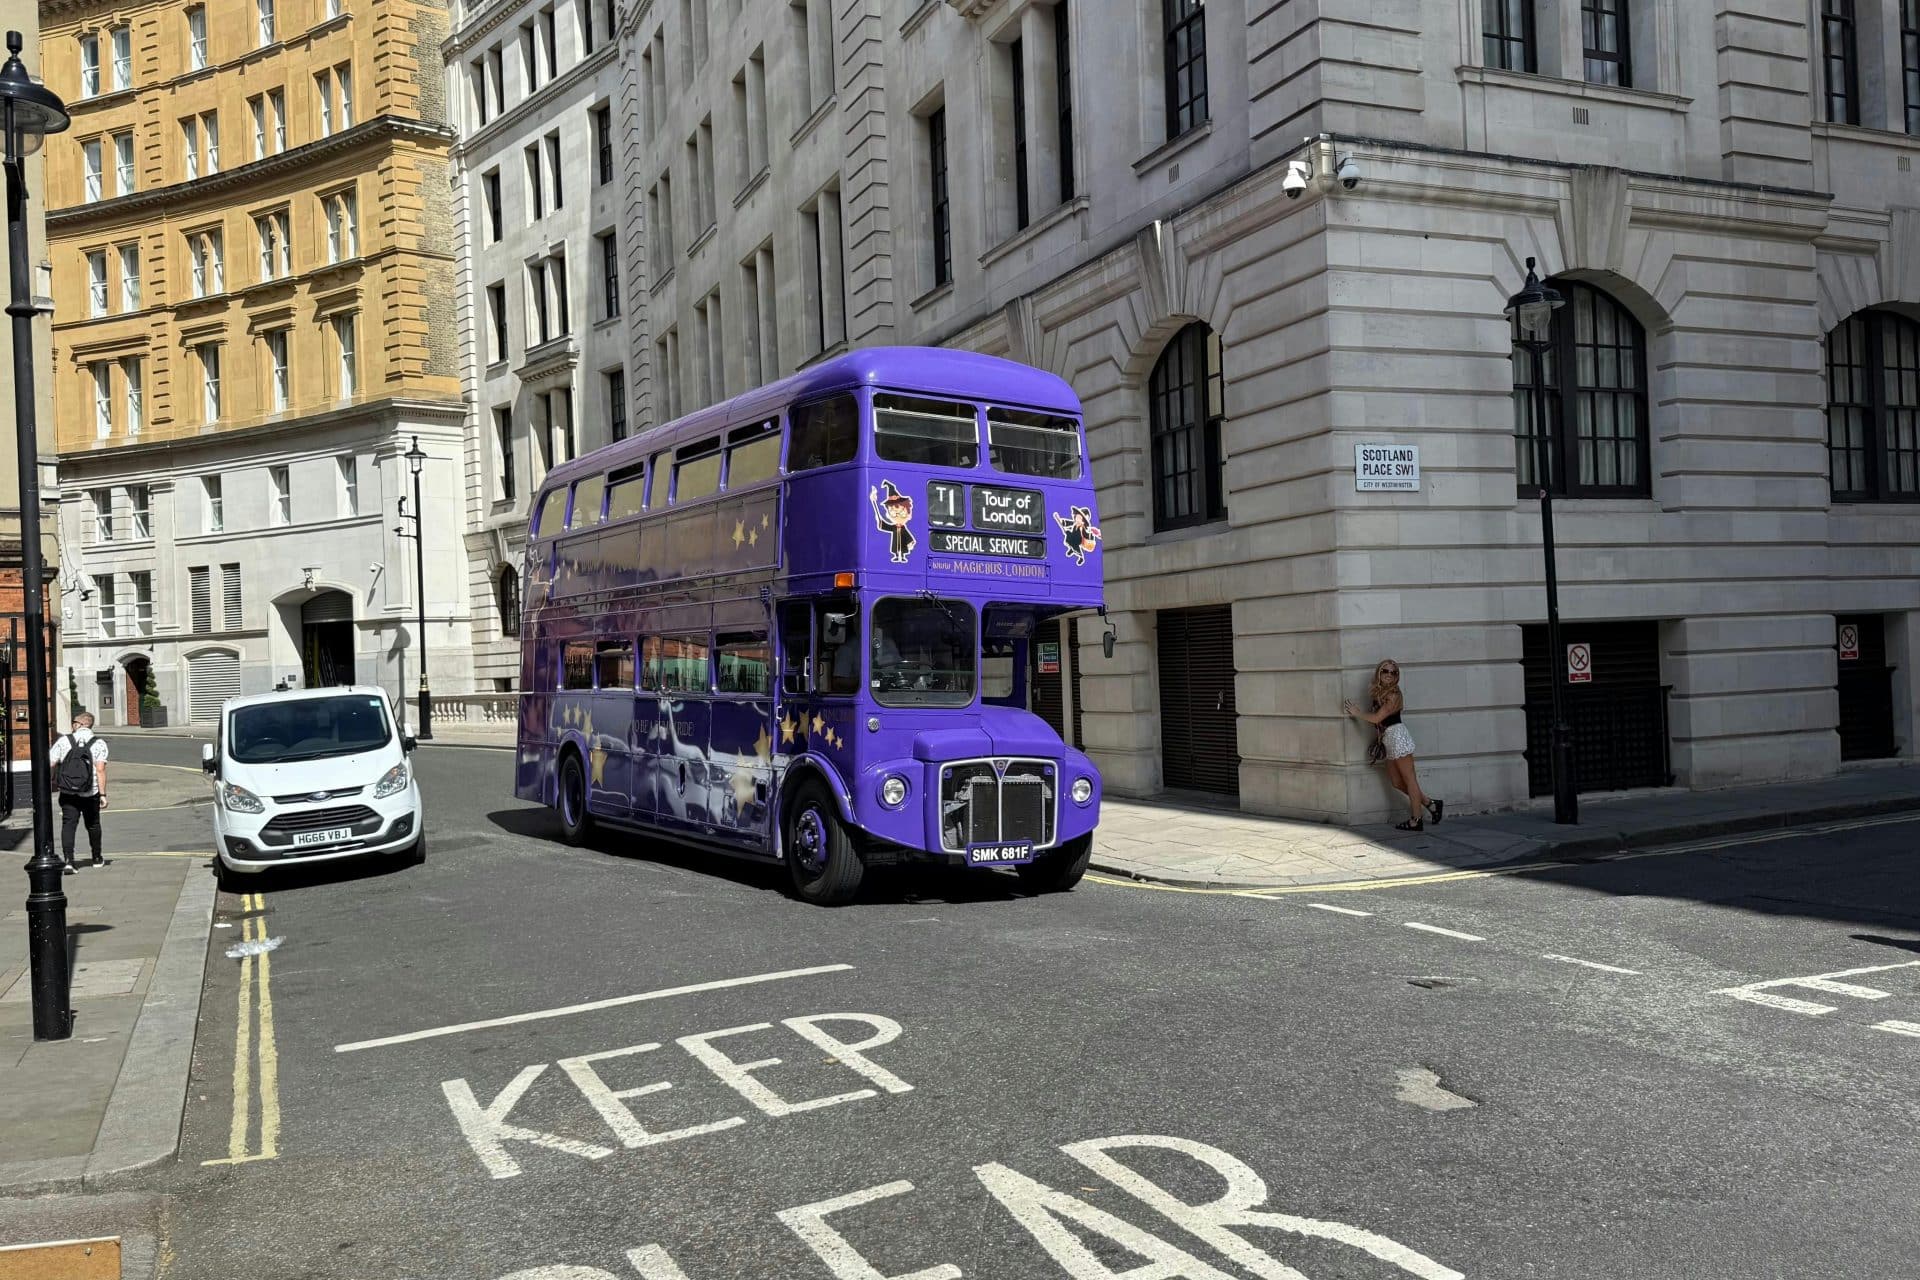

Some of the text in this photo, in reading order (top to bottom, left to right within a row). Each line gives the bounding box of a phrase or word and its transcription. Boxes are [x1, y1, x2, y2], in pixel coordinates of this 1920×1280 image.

[1362, 449, 1413, 461] SCOTLAND
[1363, 463, 1414, 476] PLACE SW1
[982, 491, 1031, 509] Tour of
[982, 507, 1032, 525] London
[945, 534, 1029, 555] SPECIAL SERVICE
[298, 829, 348, 844] HG66 VBJ
[972, 846, 1028, 861] SMK 681F
[441, 1012, 914, 1179] KEEP
